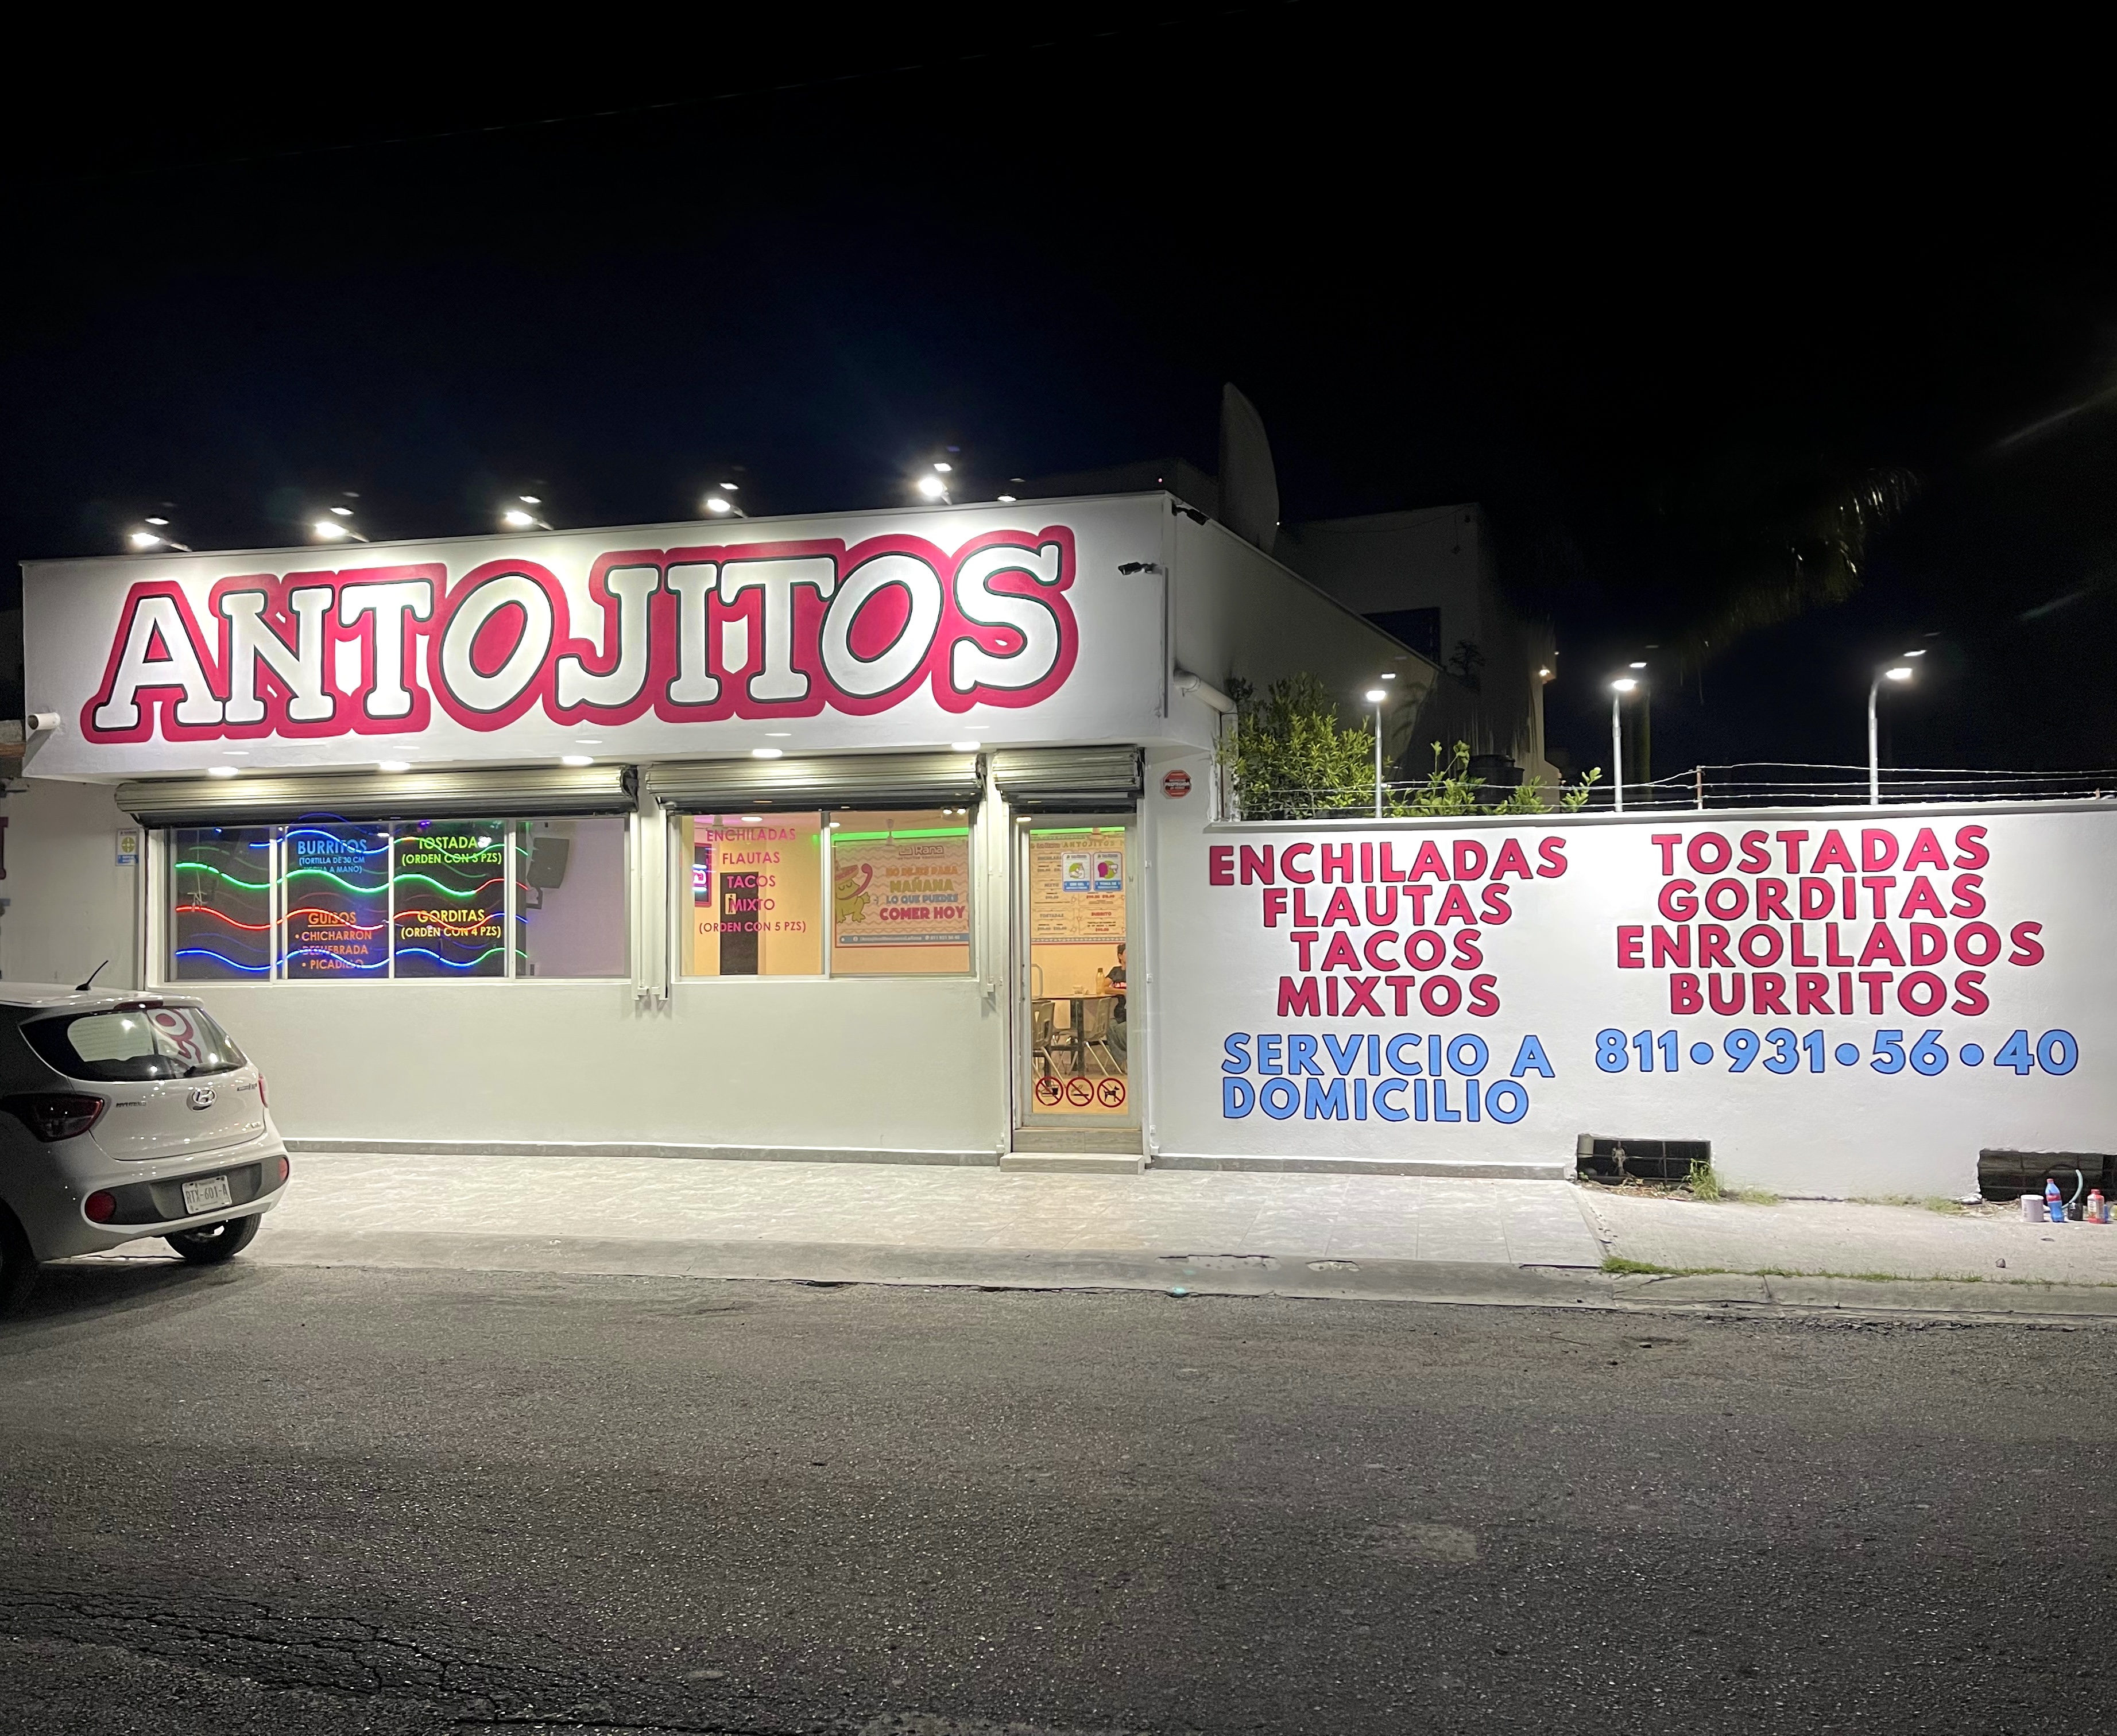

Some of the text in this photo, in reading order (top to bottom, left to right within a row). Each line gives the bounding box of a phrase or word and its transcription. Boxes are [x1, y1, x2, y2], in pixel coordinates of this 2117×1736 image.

[80, 525, 1079, 744] ANTOJITOS
[707, 828, 796, 842] ENCHILADAS
[297, 839, 367, 854] BURRITOS
[419, 836, 485, 849] TOSTADA
[915, 845, 944, 855] Rana
[1651, 825, 1990, 876] TOSTADAS
[299, 857, 331, 866] (TORTILLA
[402, 854, 441, 866] (ORDEN
[444, 853, 469, 863] CON
[481, 852, 502, 865] PZS)
[722, 852, 780, 864] FLAUTAS
[1209, 836, 1568, 885] ENCHILADAS
[727, 875, 776, 888] TACOS
[890, 877, 955, 893] MAÑANA
[887, 893, 958, 904] LO QUE PUEDES
[1658, 873, 1987, 922] GORDITAS
[729, 898, 775, 912] MIXTO
[1263, 882, 1512, 928] FLAUTAS
[308, 912, 356, 924] GUISOS
[417, 909, 485, 923] GORDITAS
[880, 906, 966, 920] COMER HOY
[401, 926, 501, 940] (ORDEN CON 4 PZS)
[699, 921, 806, 934] (ORDEN CON 5 PZS)
[301, 931, 371, 941] CHICHARRON
[1290, 928, 1484, 972] TACOS
[1617, 921, 2045, 969] ENROLLADOS
[310, 959, 364, 969] PICADILO
[1277, 974, 1500, 1017] MIXTOS
[1670, 970, 1990, 1017] BURRITOS
[1221, 1032, 1555, 1078] SERVICIO A
[1222, 1076, 1530, 1125] DOMICILIO
[185, 1183, 229, 1204] RTX-601-A
